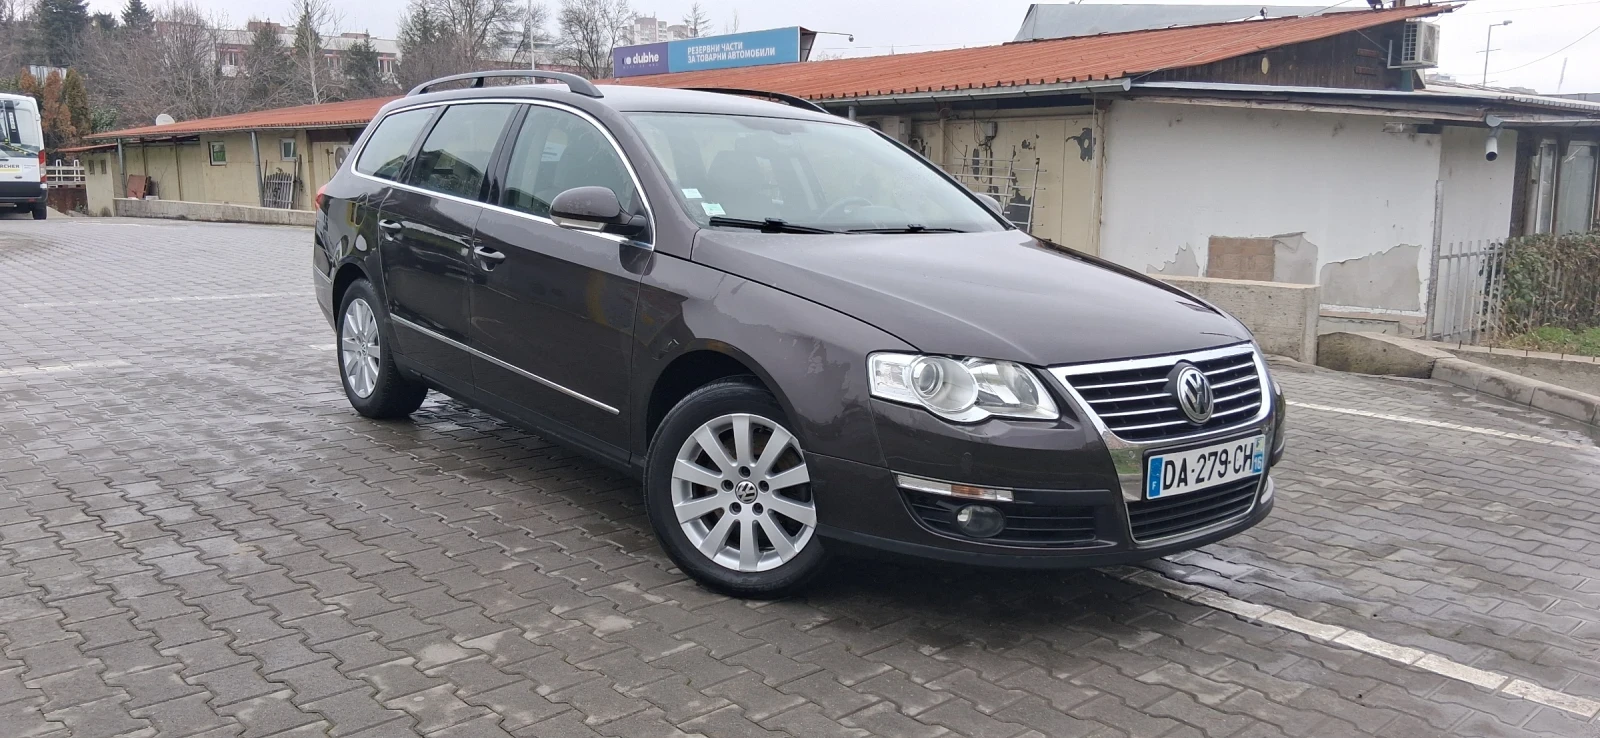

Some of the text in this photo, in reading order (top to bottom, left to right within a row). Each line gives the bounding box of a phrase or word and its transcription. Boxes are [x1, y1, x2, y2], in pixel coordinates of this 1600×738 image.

[687, 42, 743, 55] РЕЗЕРВНИ ЧАСТИ
[633, 51, 659, 64] dubhe
[688, 47, 775, 64] ЗА ТОВАРНИ АВТОМОБИЛИ
